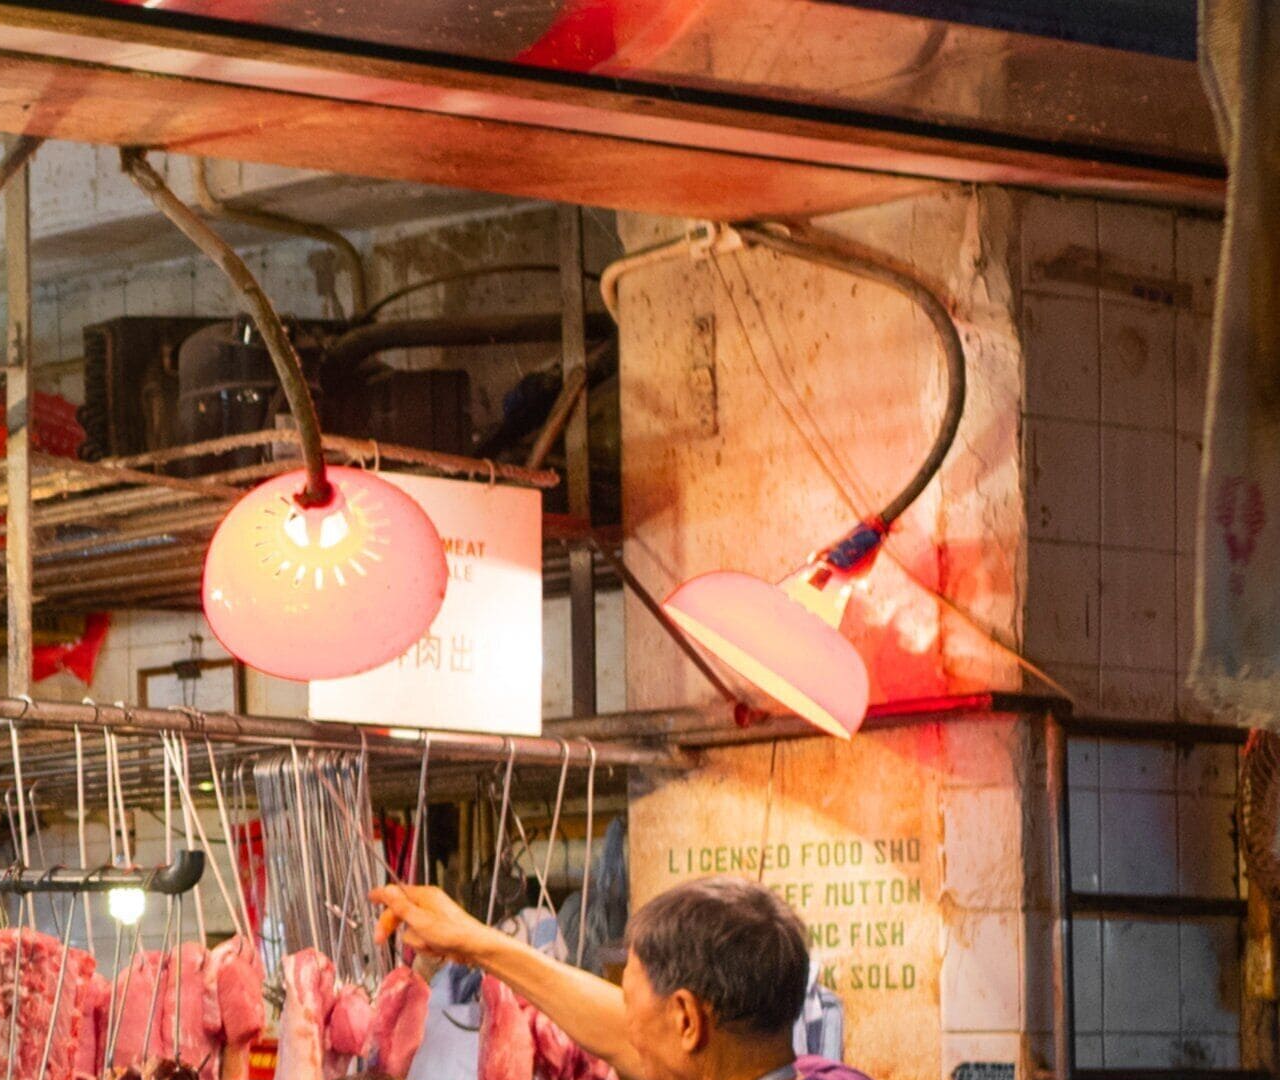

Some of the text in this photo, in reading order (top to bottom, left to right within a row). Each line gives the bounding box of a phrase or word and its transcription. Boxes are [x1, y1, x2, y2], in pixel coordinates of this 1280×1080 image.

[442, 537, 486, 558] MEAT
[668, 843, 790, 874] LICENSED
[801, 840, 863, 868] FOOD
[826, 879, 922, 907] MUTTON
[850, 921, 905, 948] FISH
[850, 963, 916, 991] SOLD
